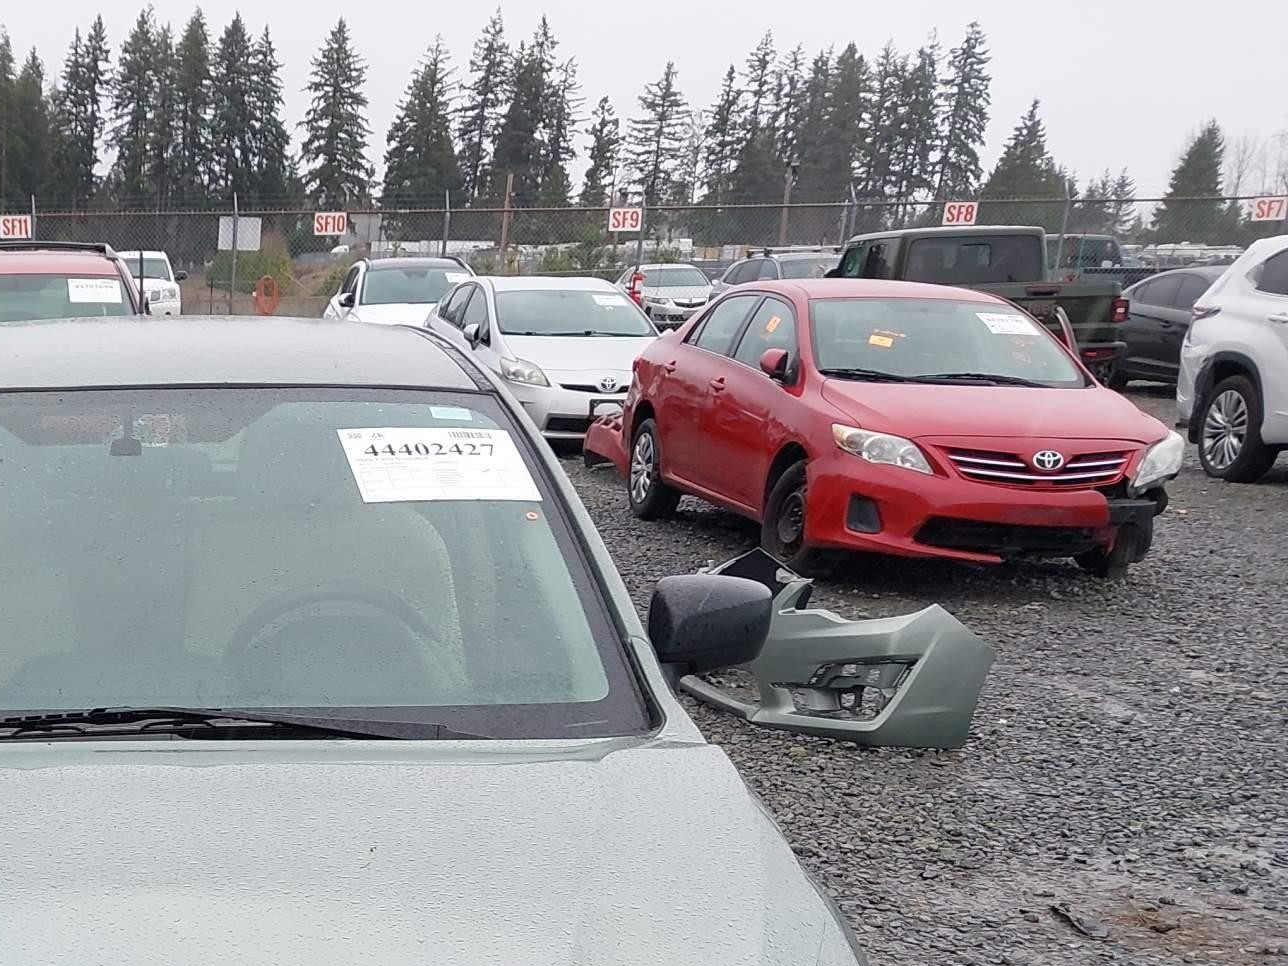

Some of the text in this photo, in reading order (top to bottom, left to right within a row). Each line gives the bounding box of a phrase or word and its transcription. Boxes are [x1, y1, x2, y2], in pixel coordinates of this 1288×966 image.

[946, 204, 974, 222] SF8
[1255, 199, 1285, 218] SF7
[2, 217, 29, 237] SF11
[315, 214, 345, 232] SF10
[612, 210, 639, 228] SF9
[363, 442, 494, 457] 44402427
